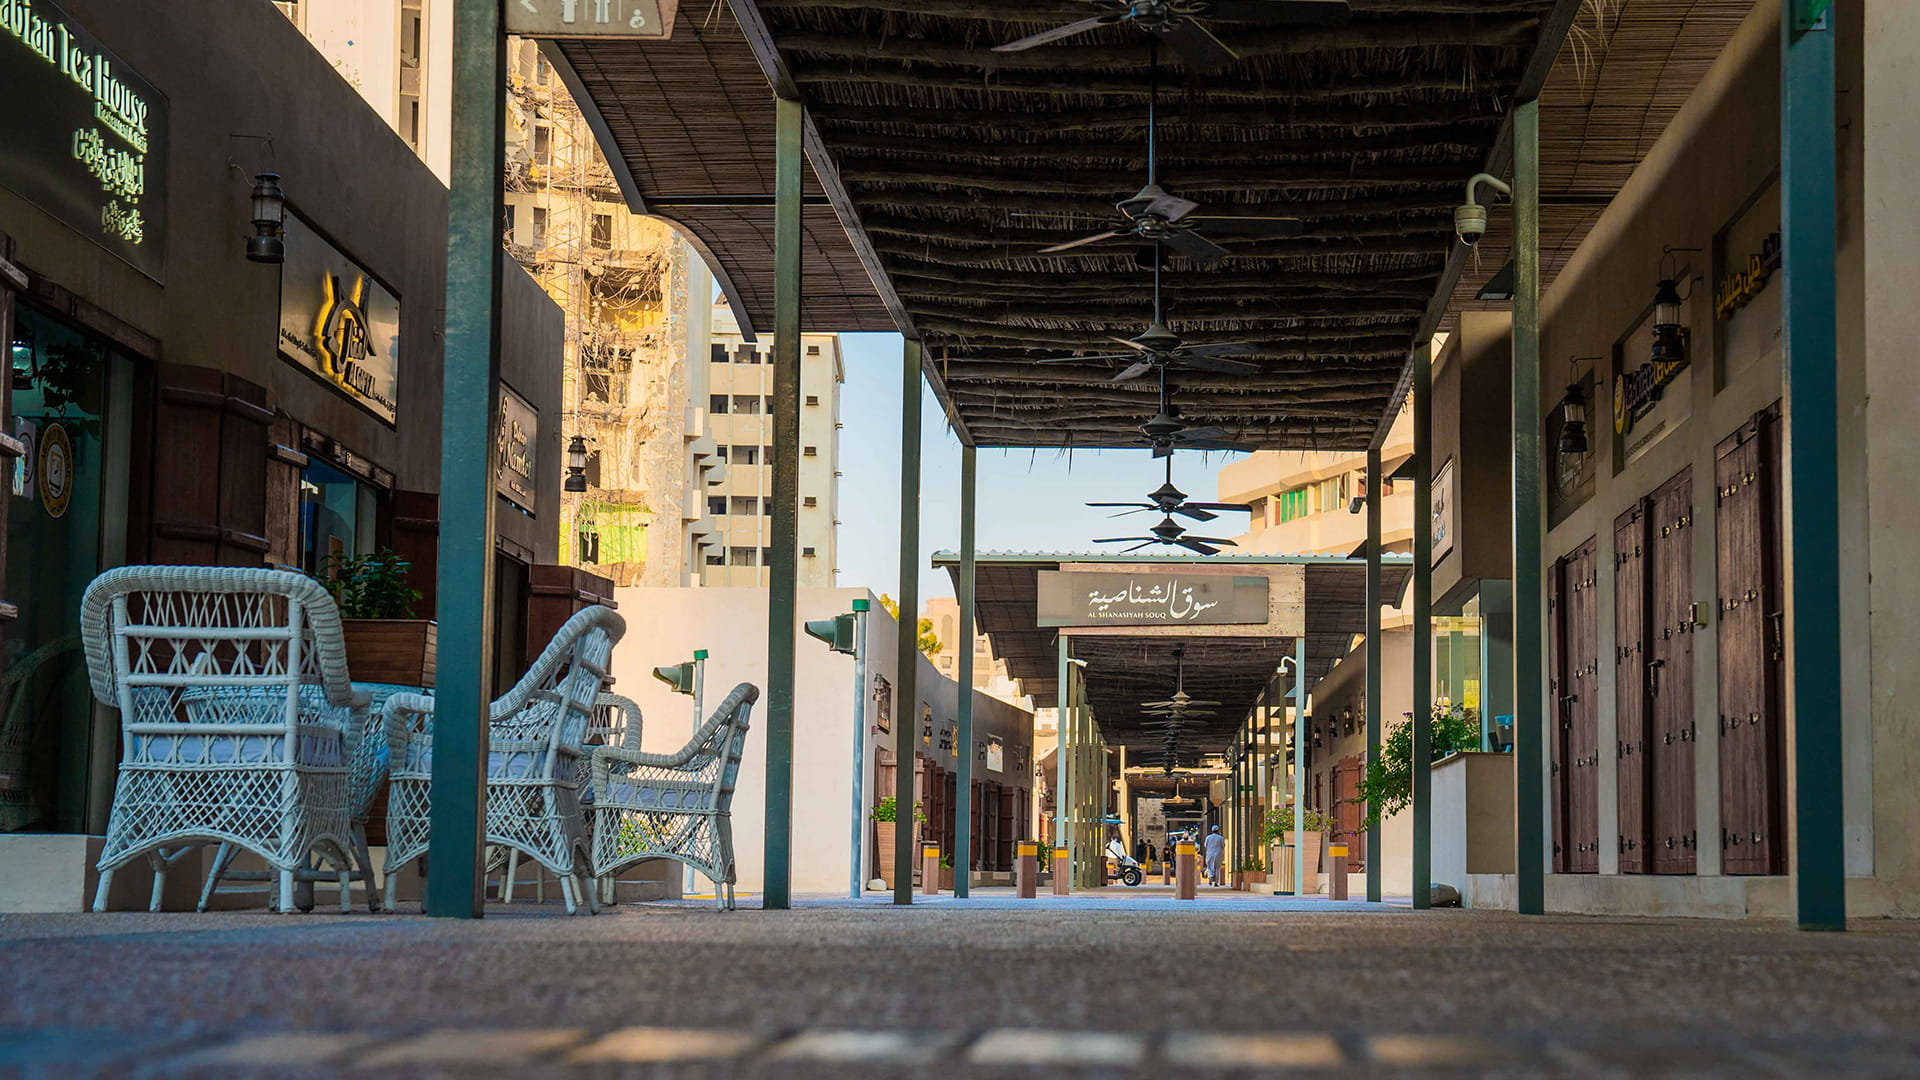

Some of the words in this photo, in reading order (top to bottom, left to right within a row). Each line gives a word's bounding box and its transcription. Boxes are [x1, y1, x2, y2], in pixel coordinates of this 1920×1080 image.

[57, 24, 93, 92] Tea
[95, 55, 149, 135] House
[1089, 580, 1177, 611] الشناصية
[1170, 584, 1218, 620] سوق
